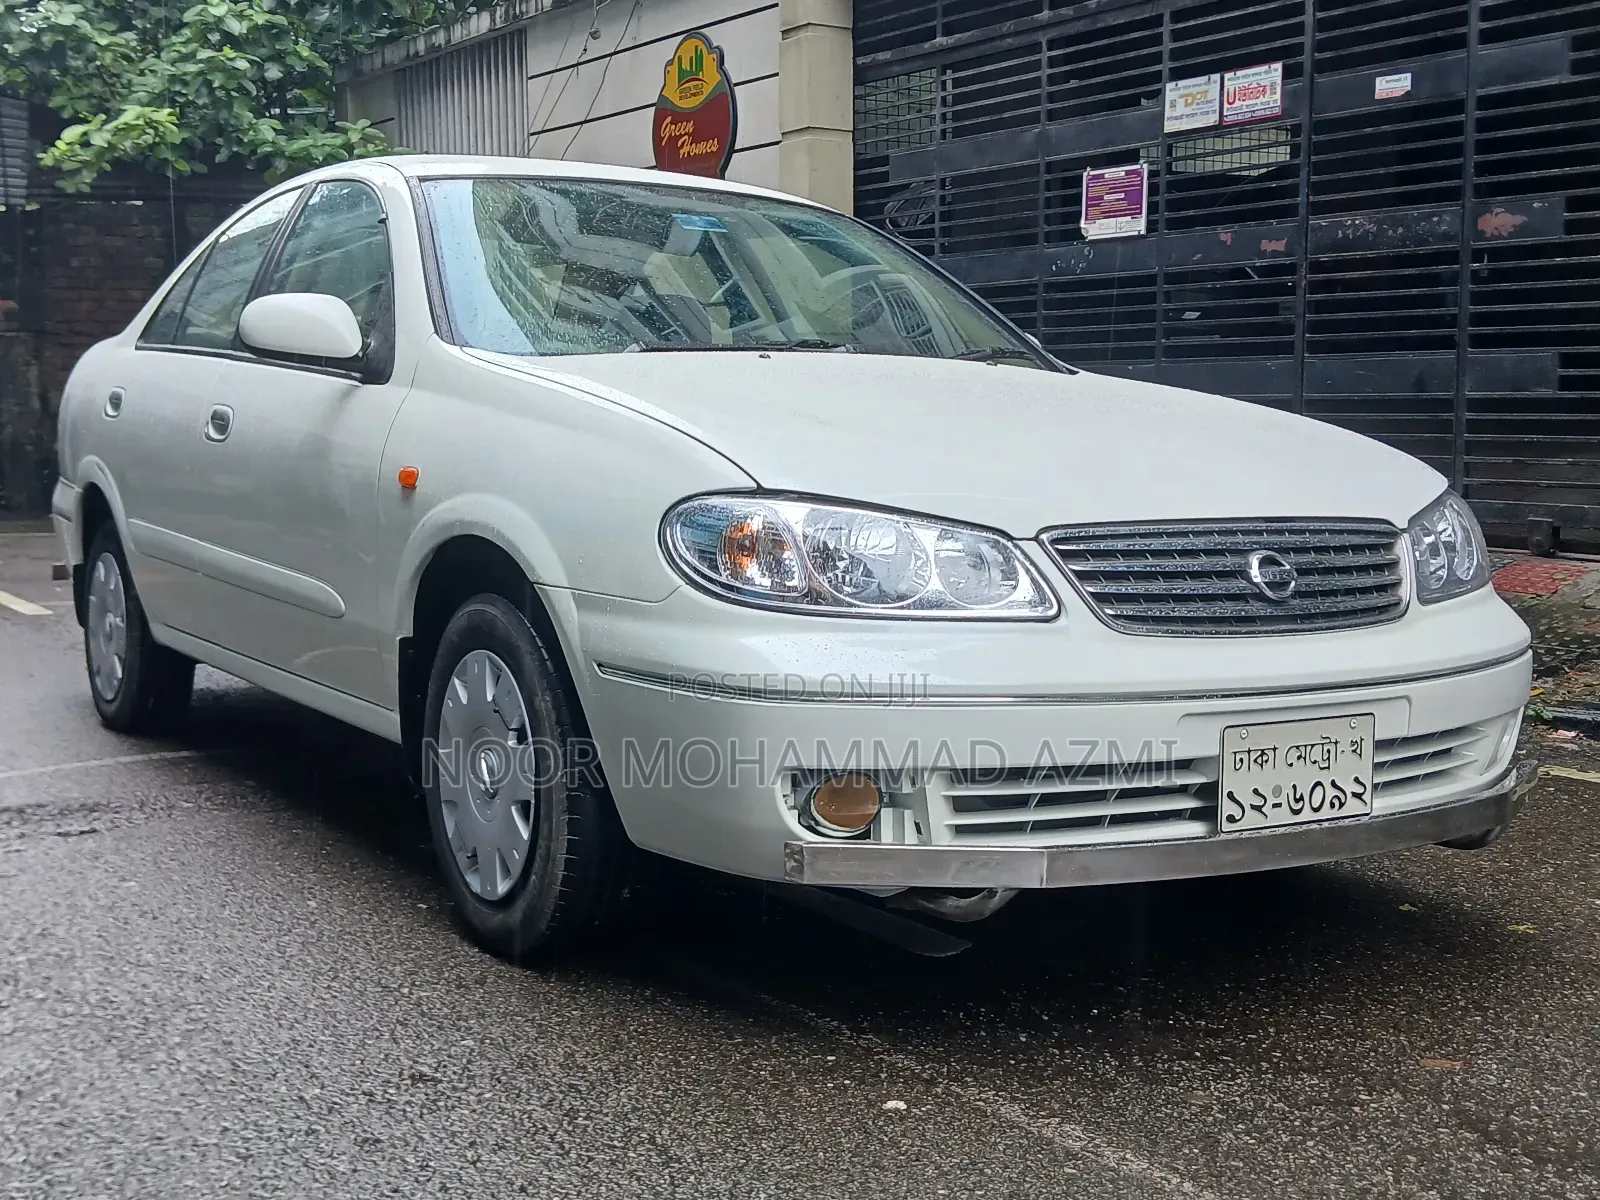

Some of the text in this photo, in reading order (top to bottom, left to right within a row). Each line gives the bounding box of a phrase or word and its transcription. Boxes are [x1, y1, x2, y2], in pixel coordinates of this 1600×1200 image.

[660, 116, 694, 146] Green
[677, 137, 719, 159] Homes
[1232, 744, 1279, 772] ঢাকা
[1225, 776, 1368, 824] ১২-৬০৯২
